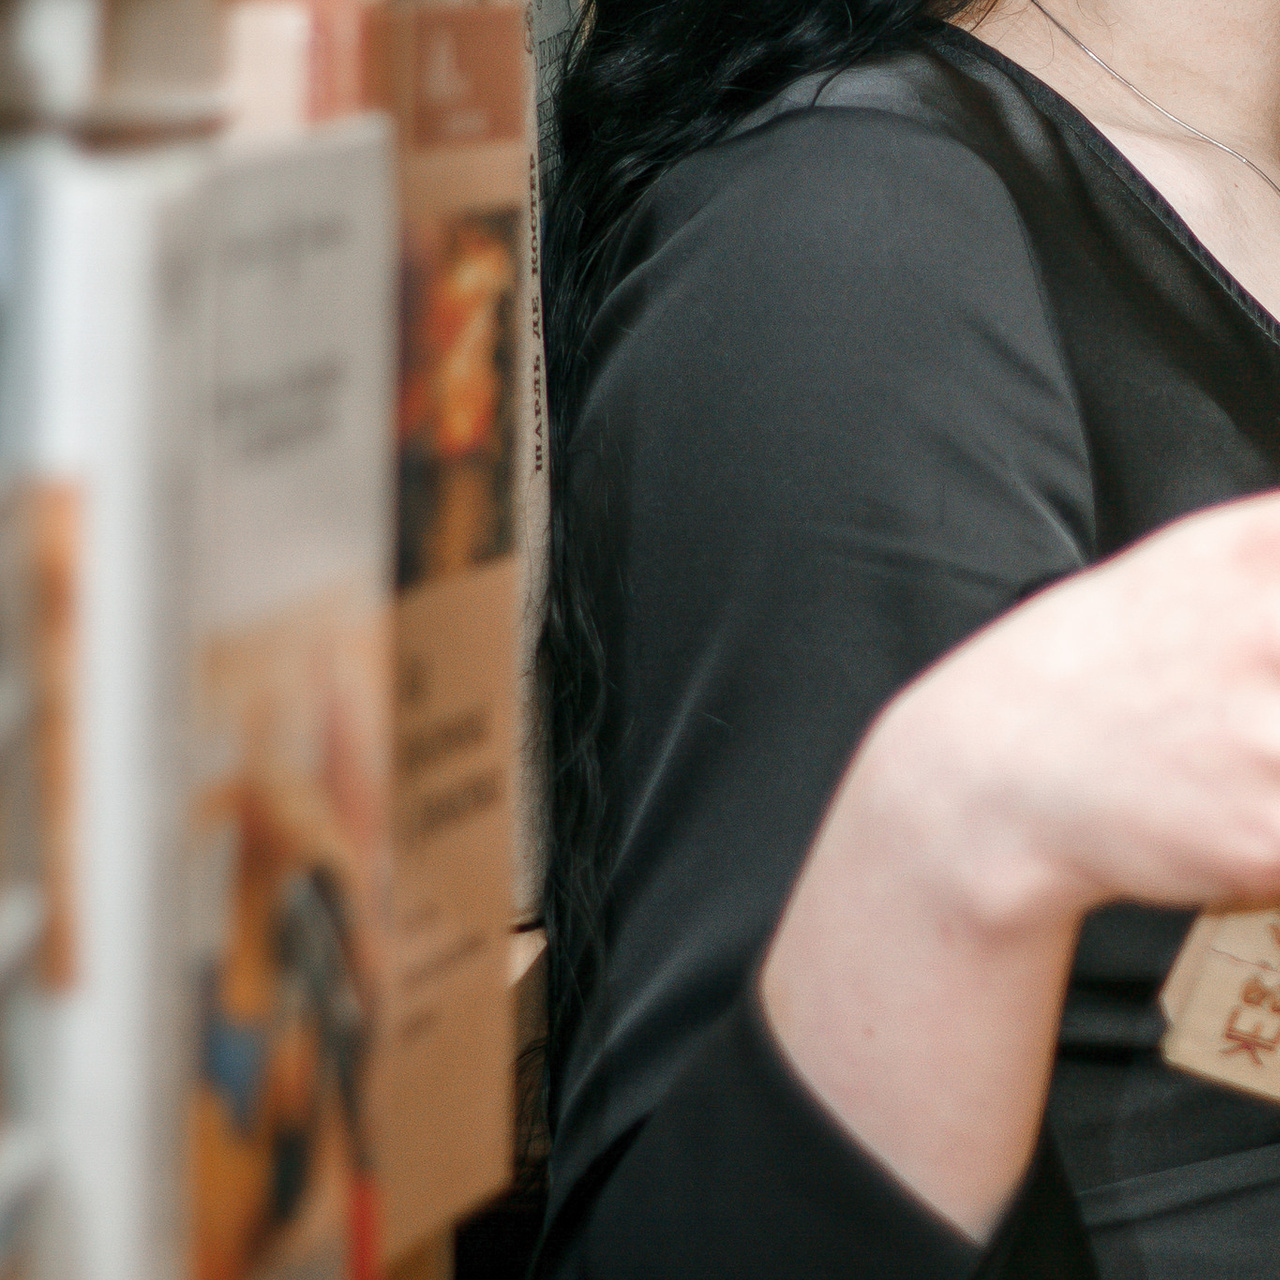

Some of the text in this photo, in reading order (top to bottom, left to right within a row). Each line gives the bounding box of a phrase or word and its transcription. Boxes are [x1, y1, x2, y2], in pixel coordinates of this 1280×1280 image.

[529, 153, 543, 473] ШАРЛЬ ДЕ КОСТЕР
